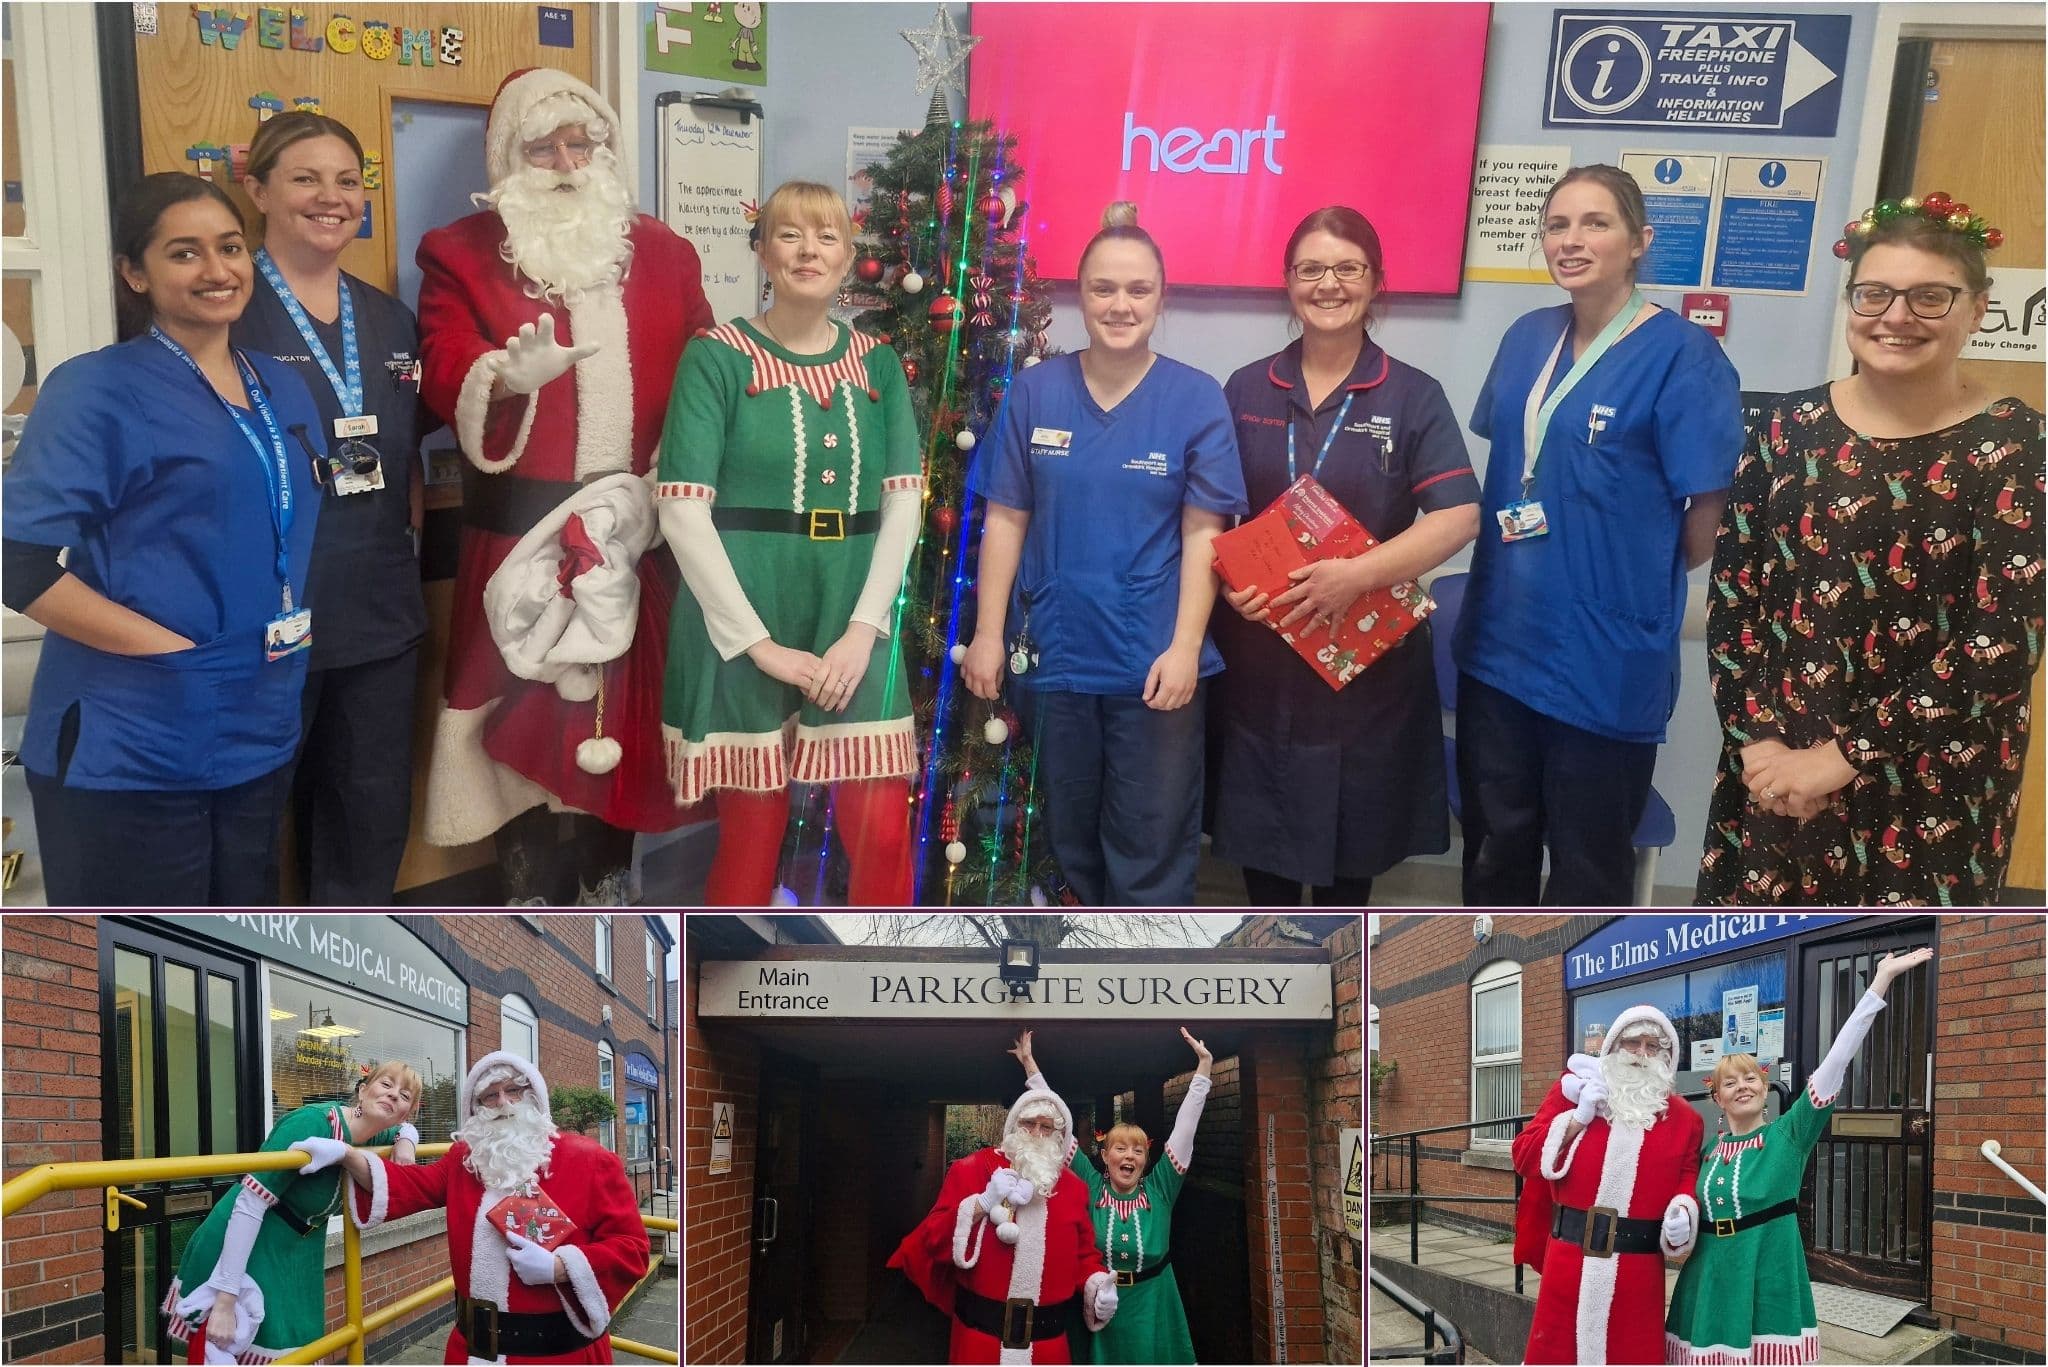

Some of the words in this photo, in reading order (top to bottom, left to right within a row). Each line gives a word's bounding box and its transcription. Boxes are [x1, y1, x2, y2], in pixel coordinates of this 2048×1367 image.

[191, 3, 463, 66] WELCOME
[1660, 24, 1785, 49] TAXI
[1657, 48, 1776, 63] FREEPHONE
[1698, 64, 1731, 74] PLUS
[1659, 73, 1722, 86] TRAVEL
[1727, 75, 1768, 87] INFO
[1706, 86, 1717, 98] &
[1656, 98, 1764, 112] INFORMATION
[1665, 110, 1752, 123] HELPLINES
[1122, 111, 1286, 175] heart
[1479, 159, 1488, 169] If
[1492, 162, 1514, 171] you
[1518, 160, 1558, 172] require
[1478, 174, 1520, 186] privacy
[1525, 175, 1556, 185] while
[678, 182, 693, 195] The
[1474, 188, 1510, 197] breast
[1515, 188, 1550, 198] feedin
[732, 204, 741, 215] to
[1485, 203, 1511, 212] your
[1515, 202, 1542, 214] baby
[1477, 215, 1514, 226] please
[1518, 216, 1537, 226] ask
[684, 224, 693, 235] be
[695, 225, 711, 235] seen
[712, 225, 722, 239] by
[722, 227, 728, 236] a
[1479, 230, 1527, 239] member
[1496, 242, 1525, 252] staff
[724, 272, 740, 284] hour
[1971, 340, 1996, 349] Baby
[2000, 341, 2038, 351] Change
[250, 389, 262, 404] Our
[258, 404, 273, 426] Vision
[1591, 404, 1617, 417] NHS
[1371, 415, 1392, 425] NHS
[268, 425, 276, 434] is
[273, 441, 285, 459] Star
[1030, 447, 1048, 455] STAFF
[1048, 449, 1070, 457] NURSE
[1148, 452, 1167, 461] NHS
[276, 459, 289, 489] Patient
[281, 490, 290, 510] Care
[1571, 953, 1605, 980] The
[1610, 939, 1659, 971] Elms
[1665, 914, 1767, 957] Medical
[309, 920, 396, 985] MEDICAL
[400, 962, 462, 1011] PRACTICE
[758, 967, 809, 986] Main
[1096, 977, 1293, 1005] SURGERY
[738, 990, 829, 1010] Entrance
[1346, 1200, 1362, 1214] DAN
